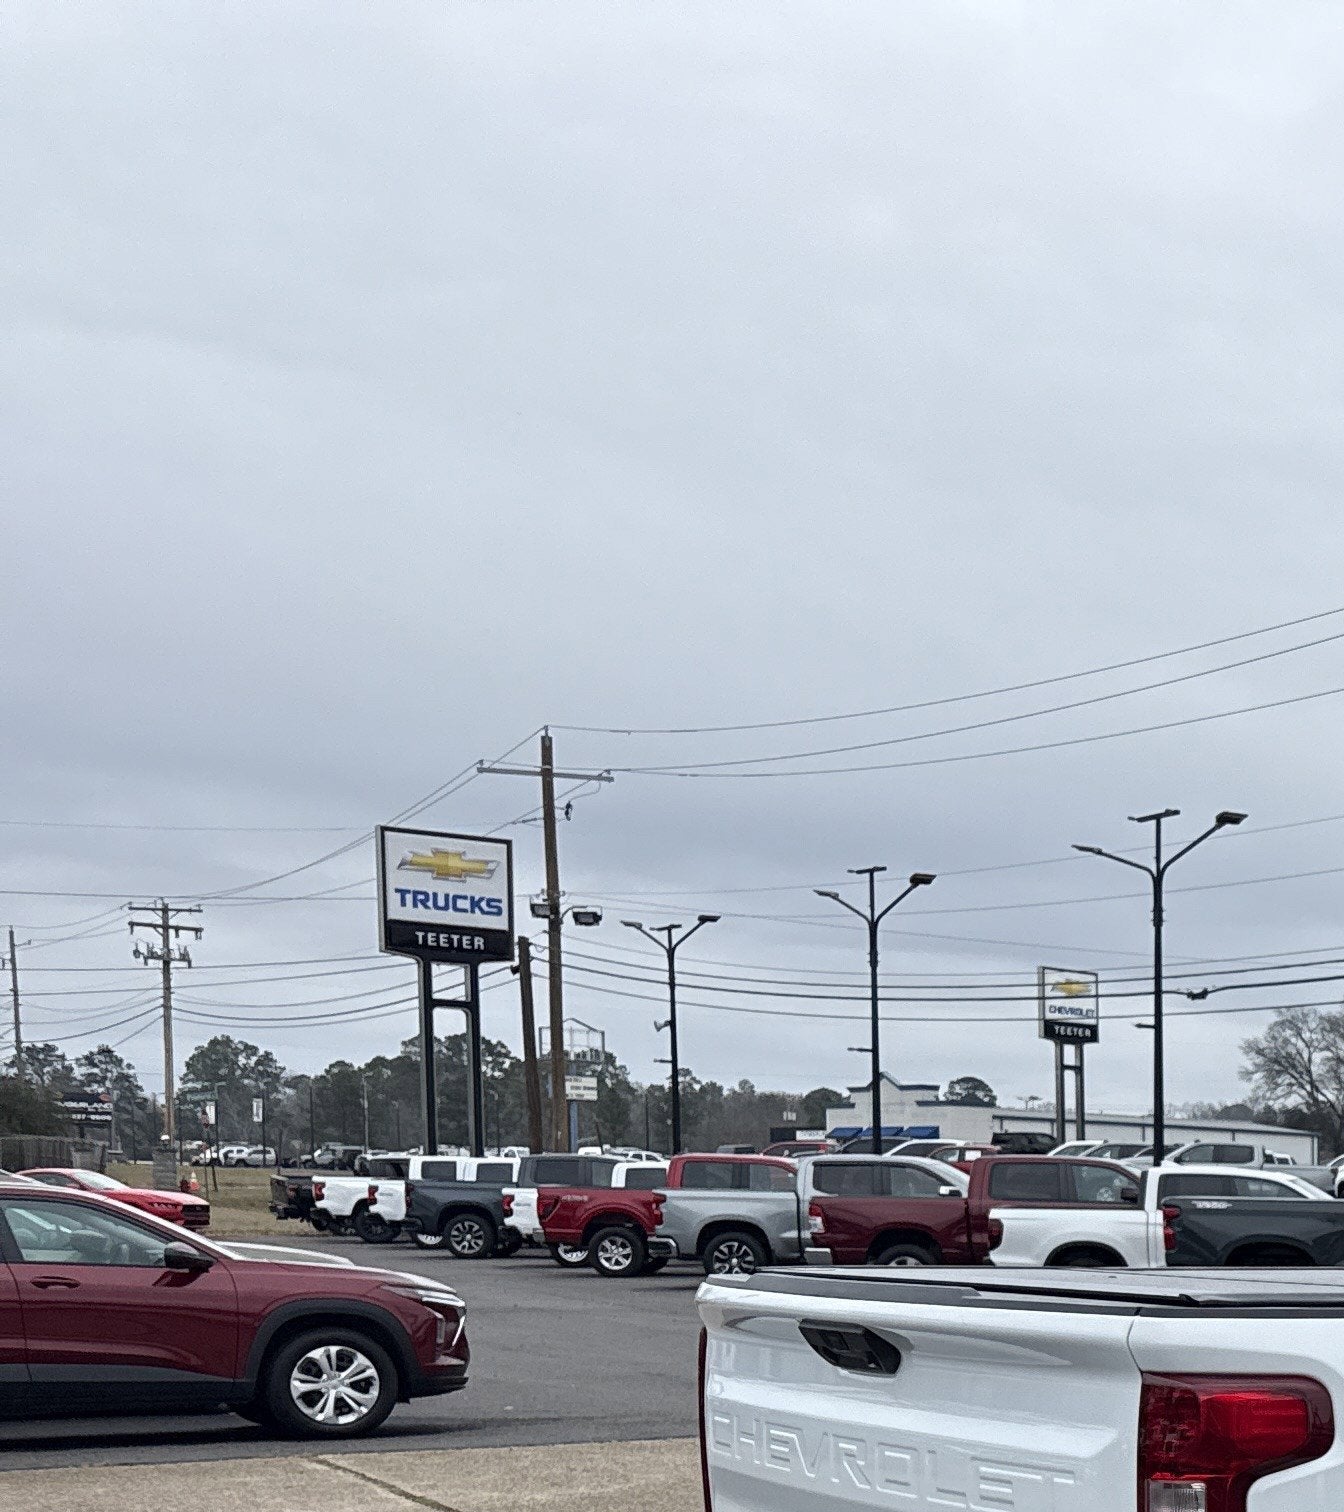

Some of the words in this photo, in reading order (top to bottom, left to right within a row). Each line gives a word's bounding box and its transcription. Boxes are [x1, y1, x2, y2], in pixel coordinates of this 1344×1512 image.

[394, 887, 503, 917] TRUCKS
[415, 931, 485, 950] TEETER
[1048, 1004, 1095, 1018] CHEVROLET
[1053, 1024, 1091, 1037] TEETER
